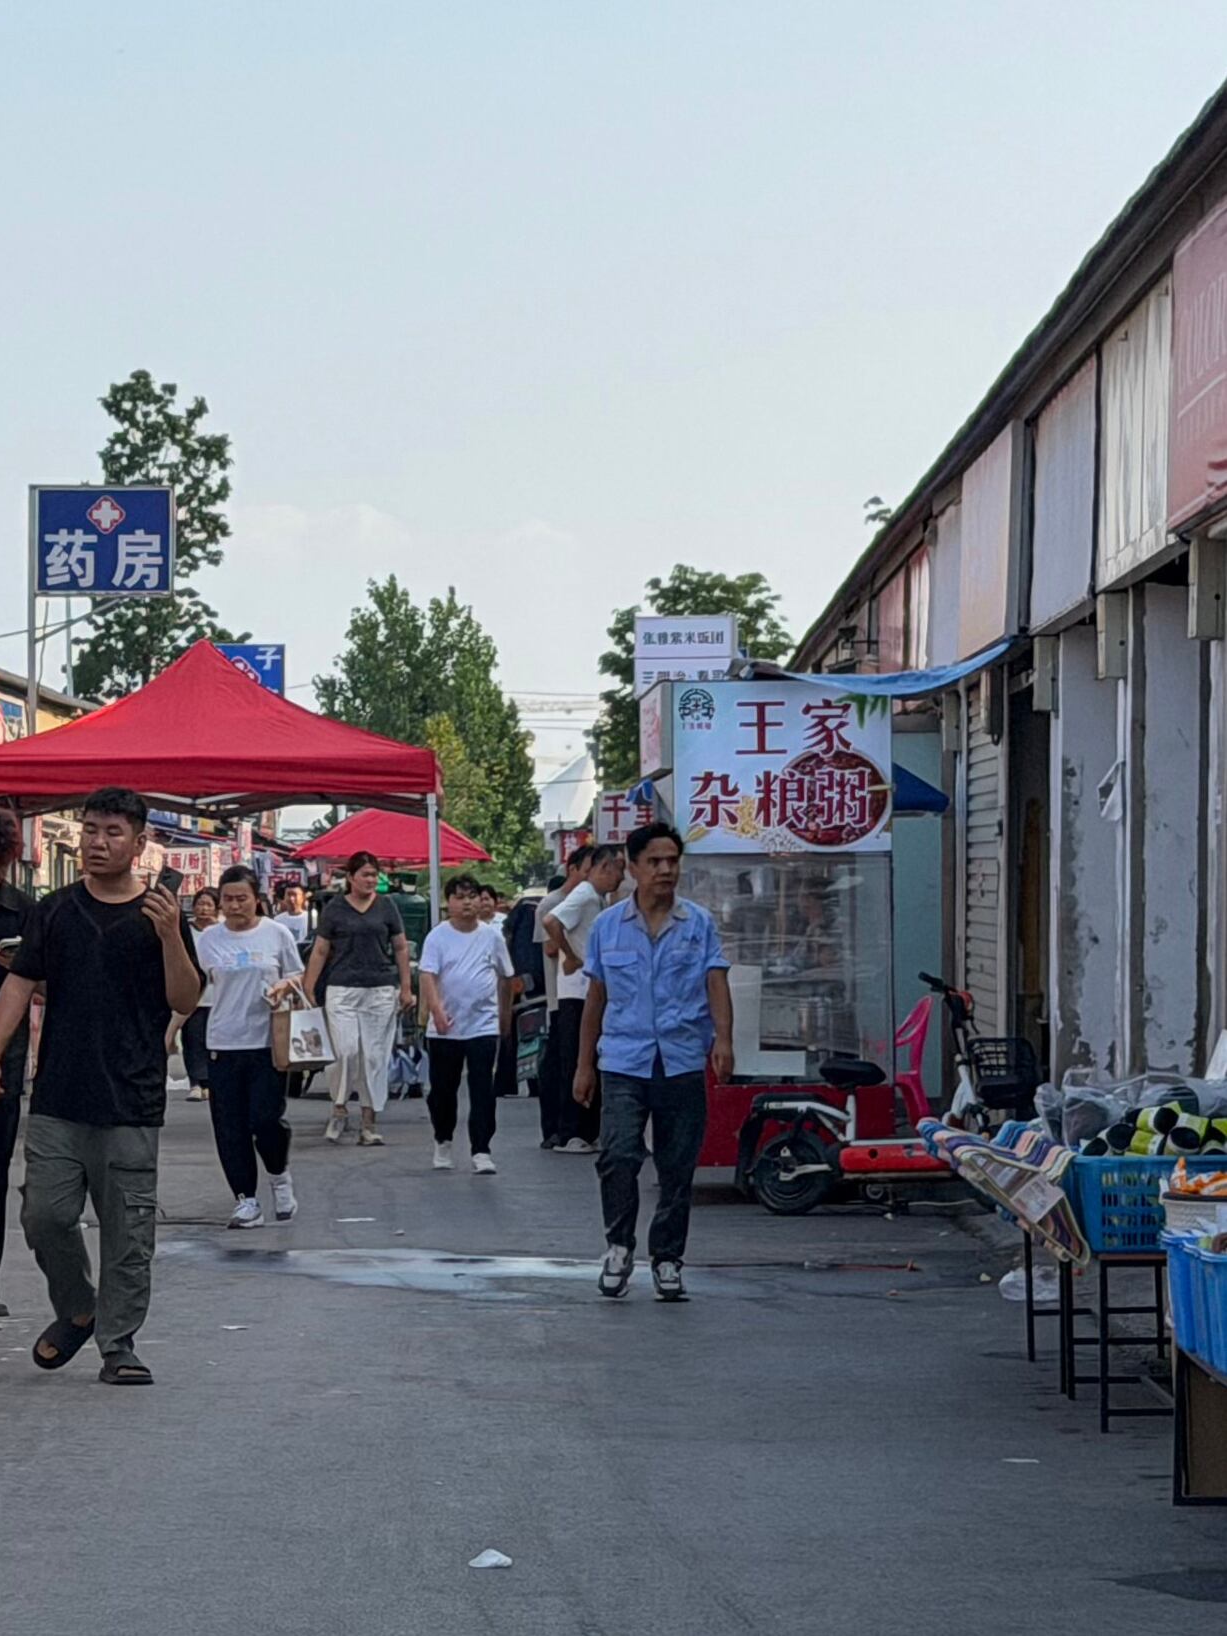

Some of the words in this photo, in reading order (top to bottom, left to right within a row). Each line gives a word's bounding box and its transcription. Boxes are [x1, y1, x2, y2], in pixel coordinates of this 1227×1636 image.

[44, 529, 164, 589] 药房
[735, 698, 852, 758] 王家
[689, 769, 871, 828] 杂粮粥
